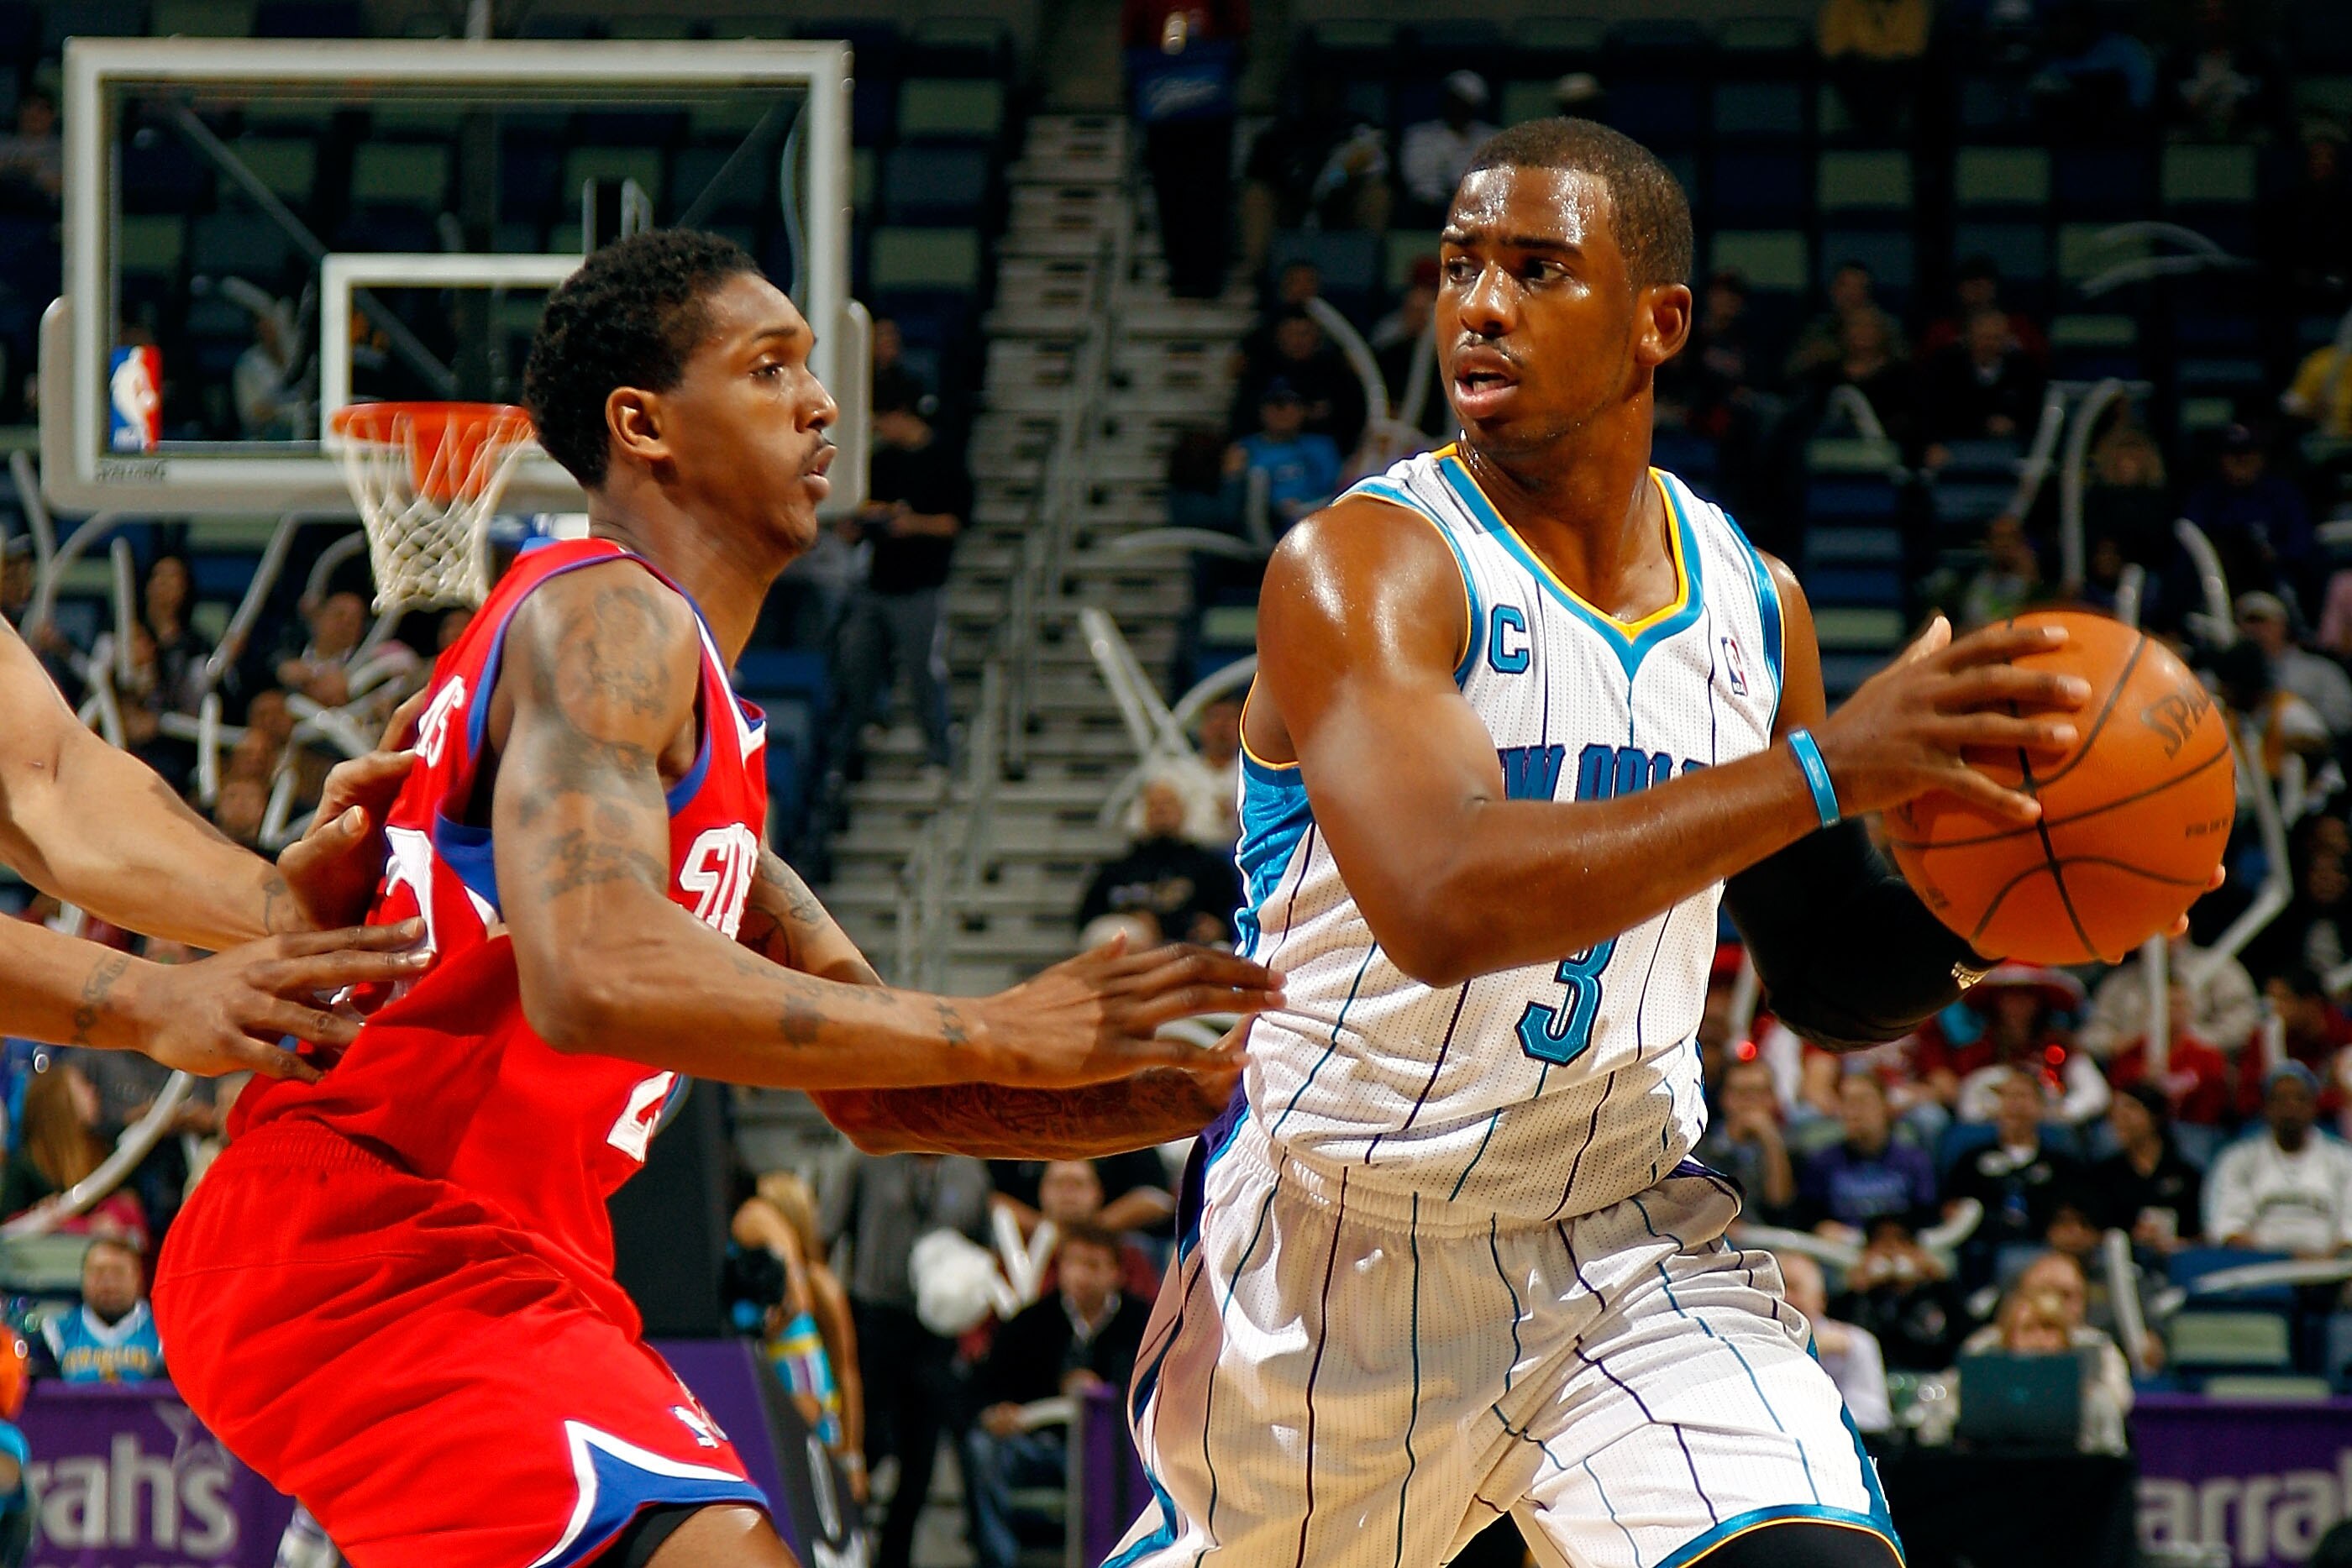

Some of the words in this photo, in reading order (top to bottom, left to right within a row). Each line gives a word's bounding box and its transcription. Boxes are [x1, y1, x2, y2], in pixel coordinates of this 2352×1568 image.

[1488, 604, 1530, 674] C
[1497, 742, 1567, 801] W
[1515, 932, 1621, 1067] 3
